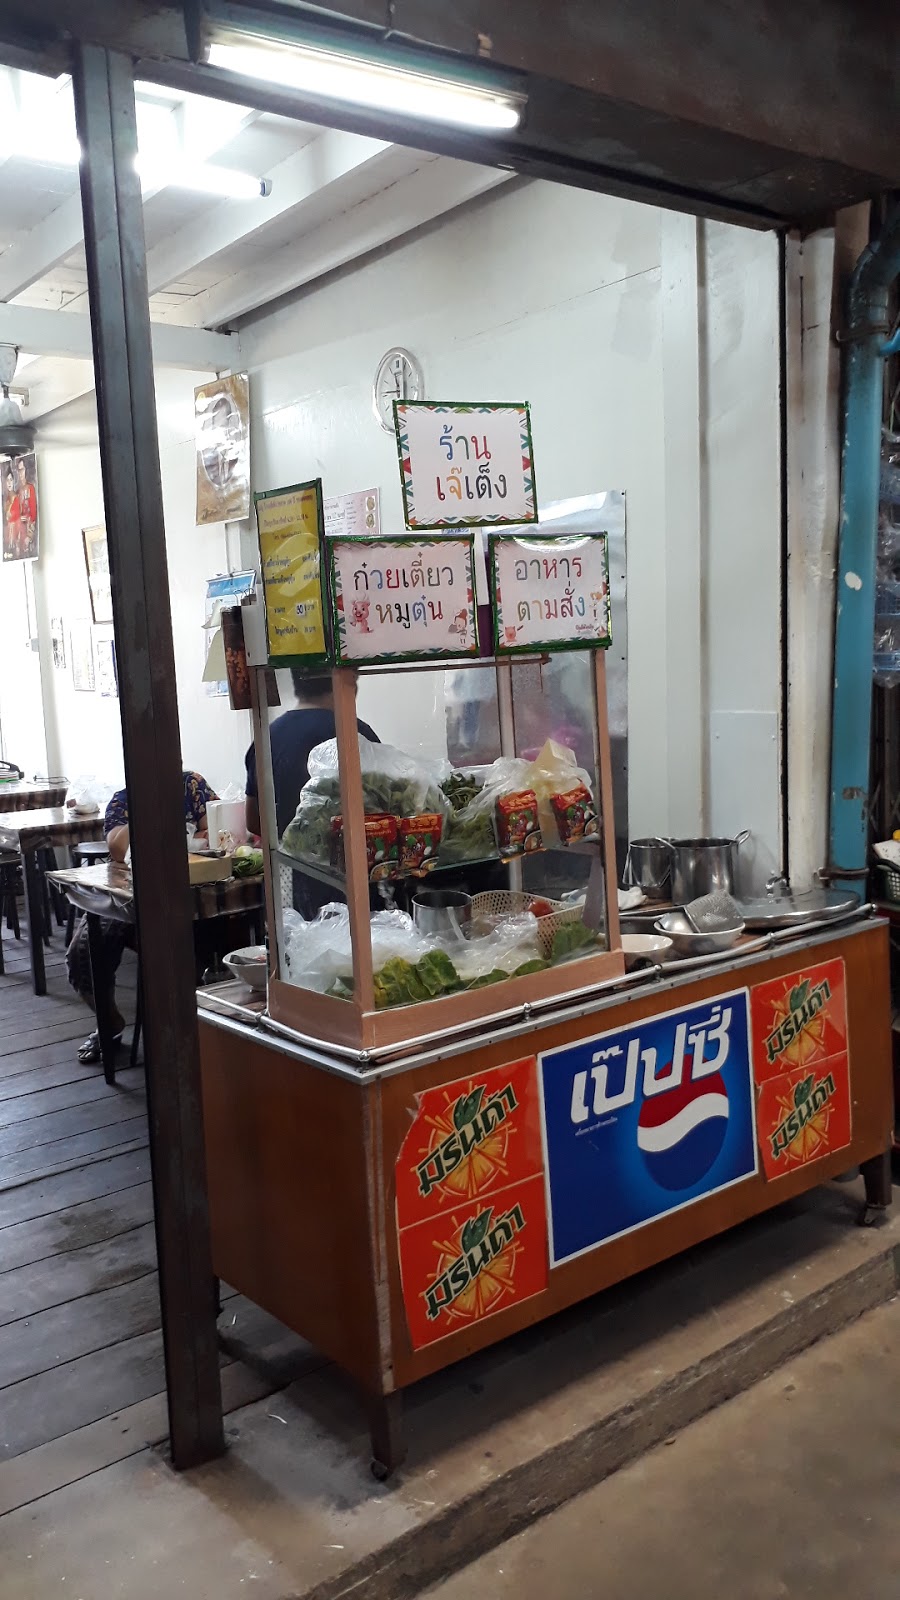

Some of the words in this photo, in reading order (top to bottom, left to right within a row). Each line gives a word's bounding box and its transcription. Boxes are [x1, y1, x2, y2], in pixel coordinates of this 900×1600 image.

[439, 424, 492, 461] ร้าน
[436, 461, 508, 501] เจ๊เต็ง
[353, 551, 454, 591] ก๋วยเตี๋ยว
[514, 557, 582, 581] อาหาร
[375, 594, 444, 629] หมูตุ๋น
[517, 580, 586, 621] ตามสั่ง
[570, 1005, 732, 1124] เป๊ปซี่
[416, 1082, 519, 1197] มิรินด้า
[424, 1201, 527, 1321] มิรินด้า
